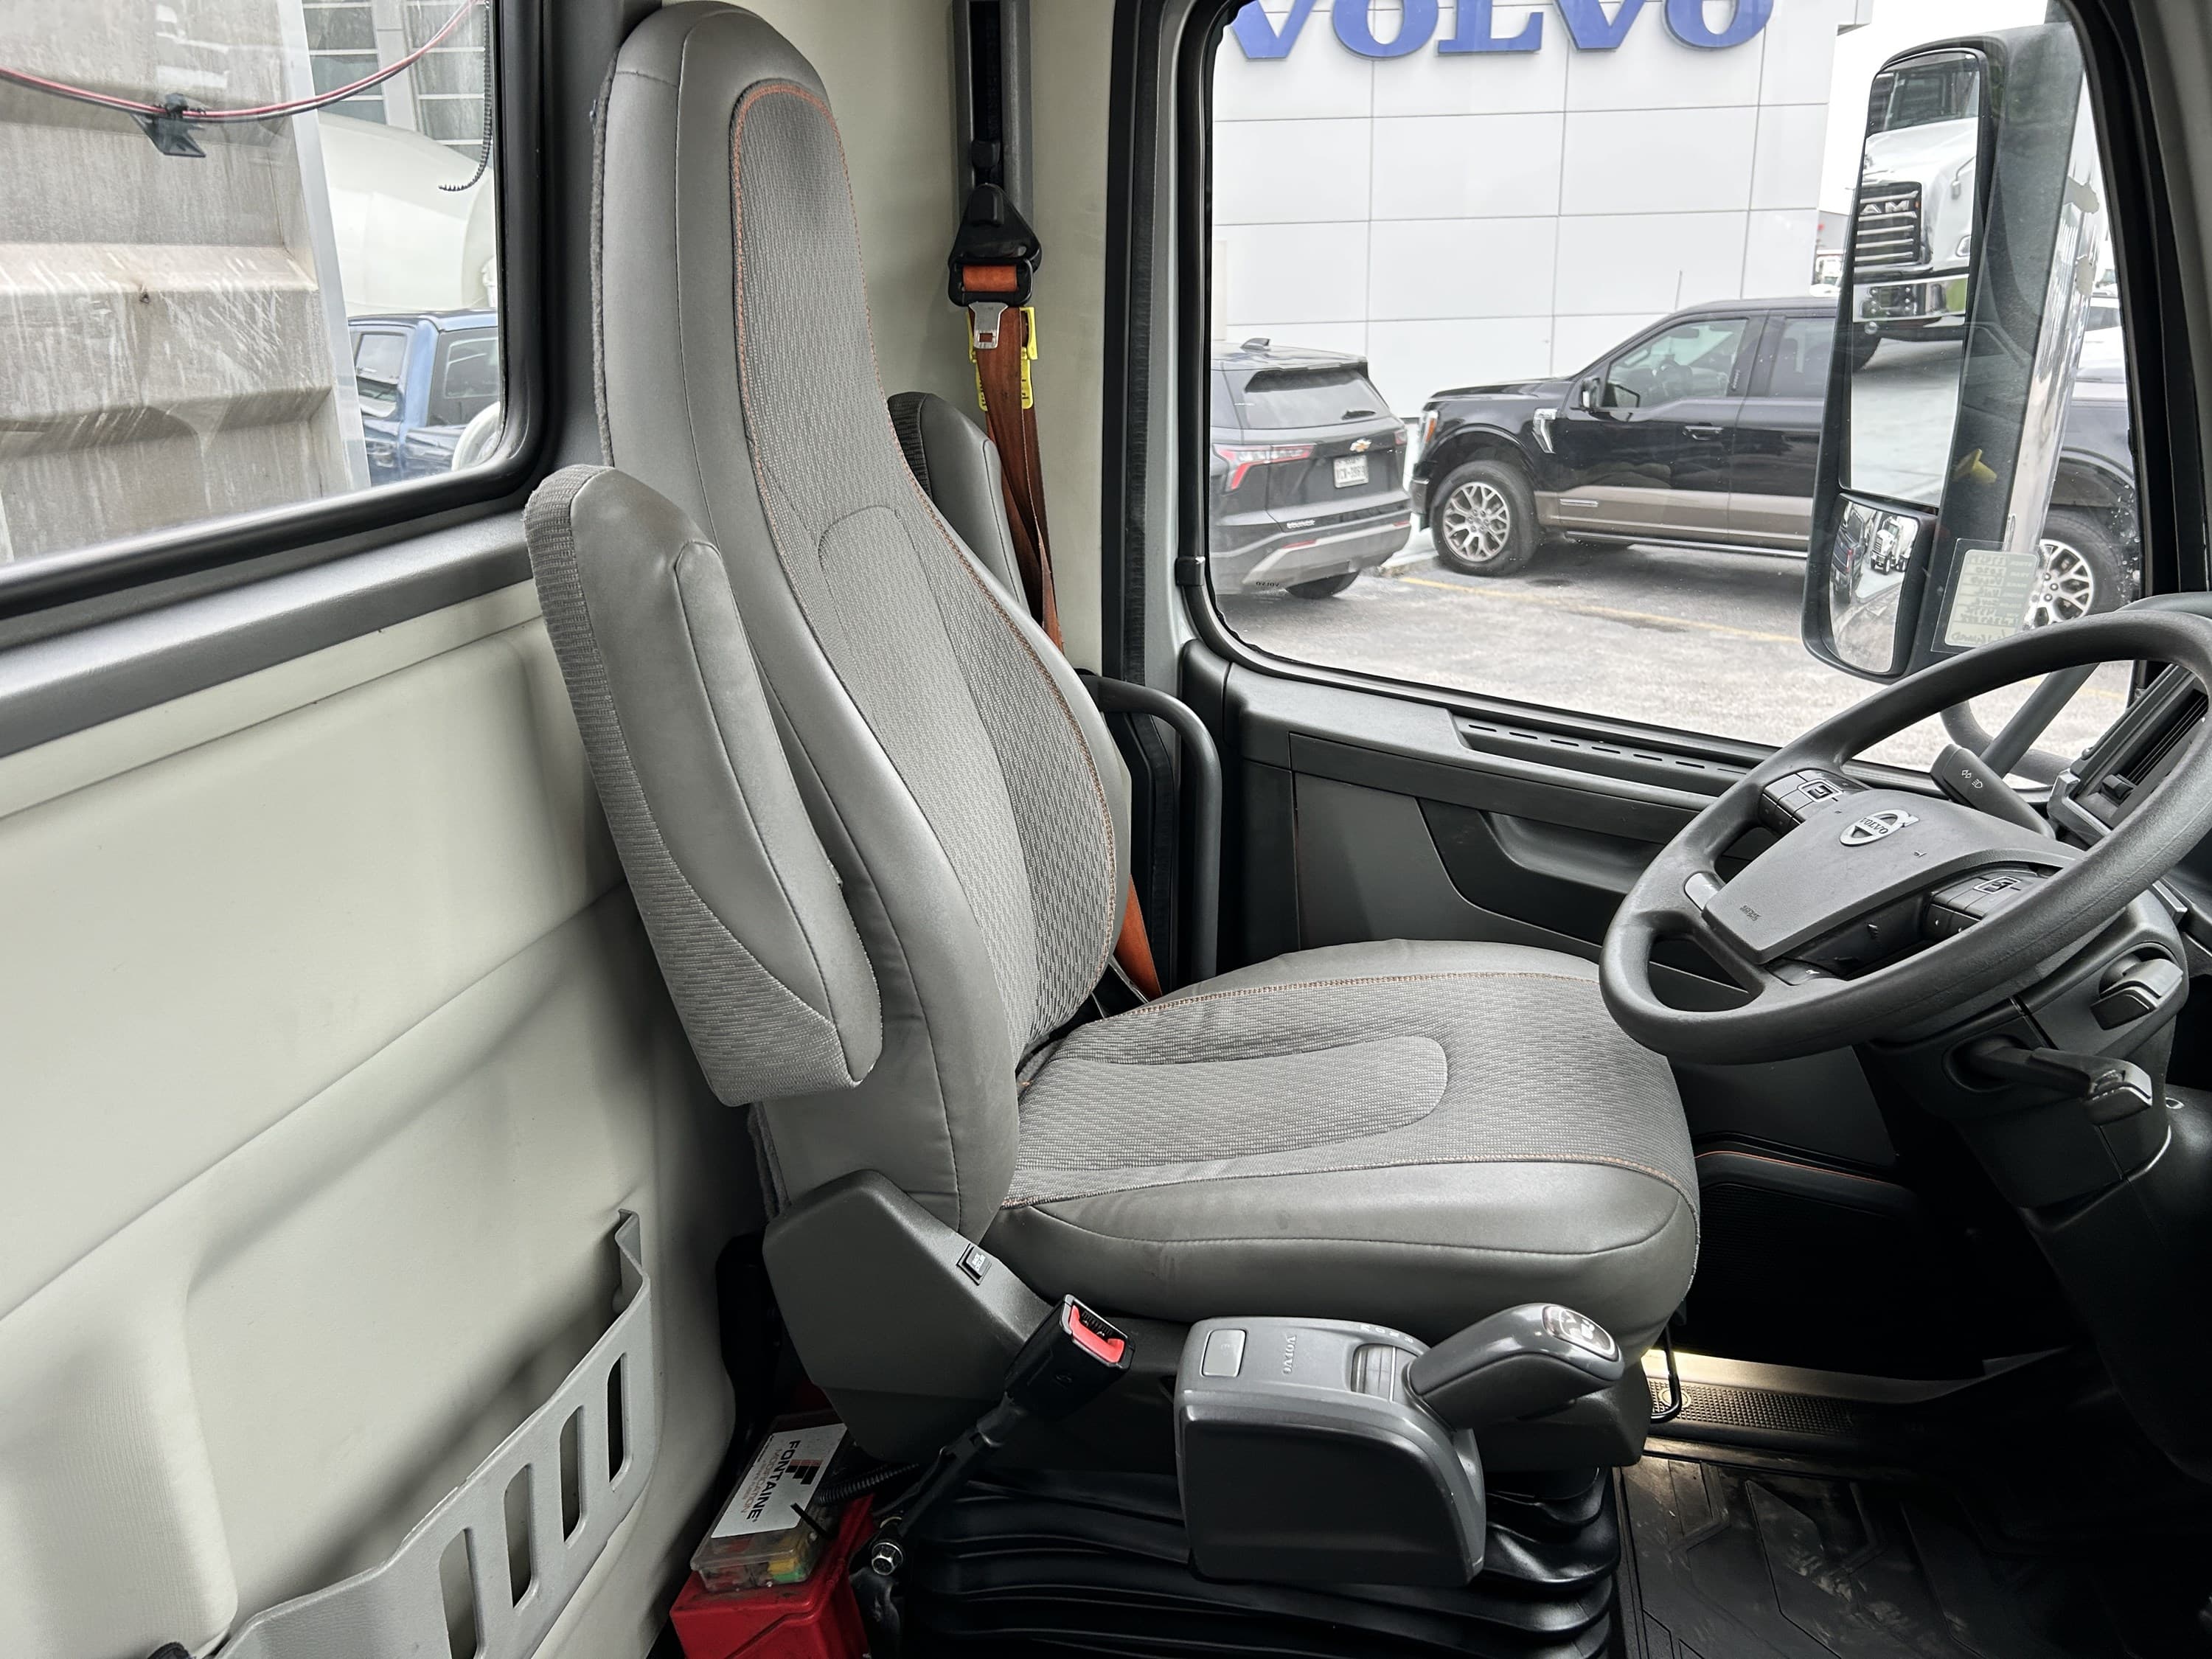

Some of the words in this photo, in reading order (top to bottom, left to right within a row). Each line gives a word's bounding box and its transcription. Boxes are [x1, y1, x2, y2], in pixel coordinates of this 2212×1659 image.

[1860, 817, 1889, 835] VOLVO
[1283, 1333, 1297, 1375] VOLVO
[746, 1439, 801, 1520] FONTAINE
